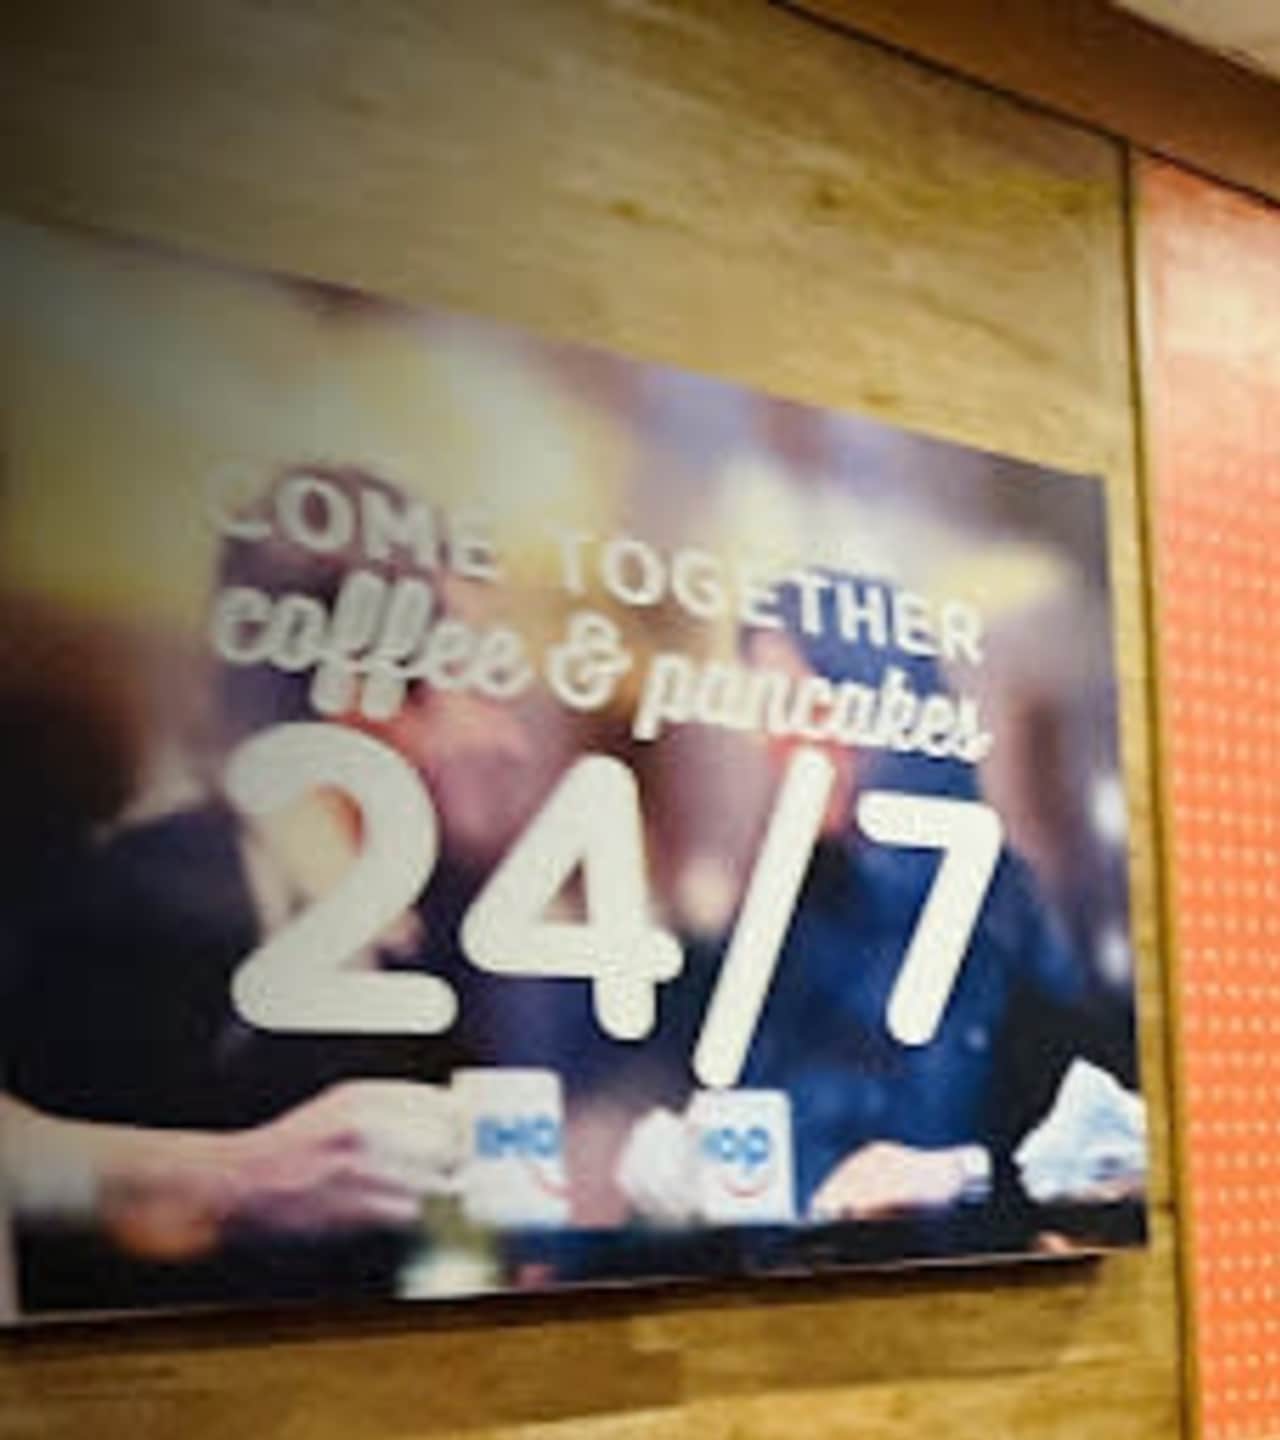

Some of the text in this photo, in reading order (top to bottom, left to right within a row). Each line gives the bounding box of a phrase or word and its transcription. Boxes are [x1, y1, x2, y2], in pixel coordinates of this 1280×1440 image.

[210, 465, 984, 663] COME TOGETHER
[216, 570, 994, 761] coffee & pancakes
[229, 721, 1002, 1088] 24/7
